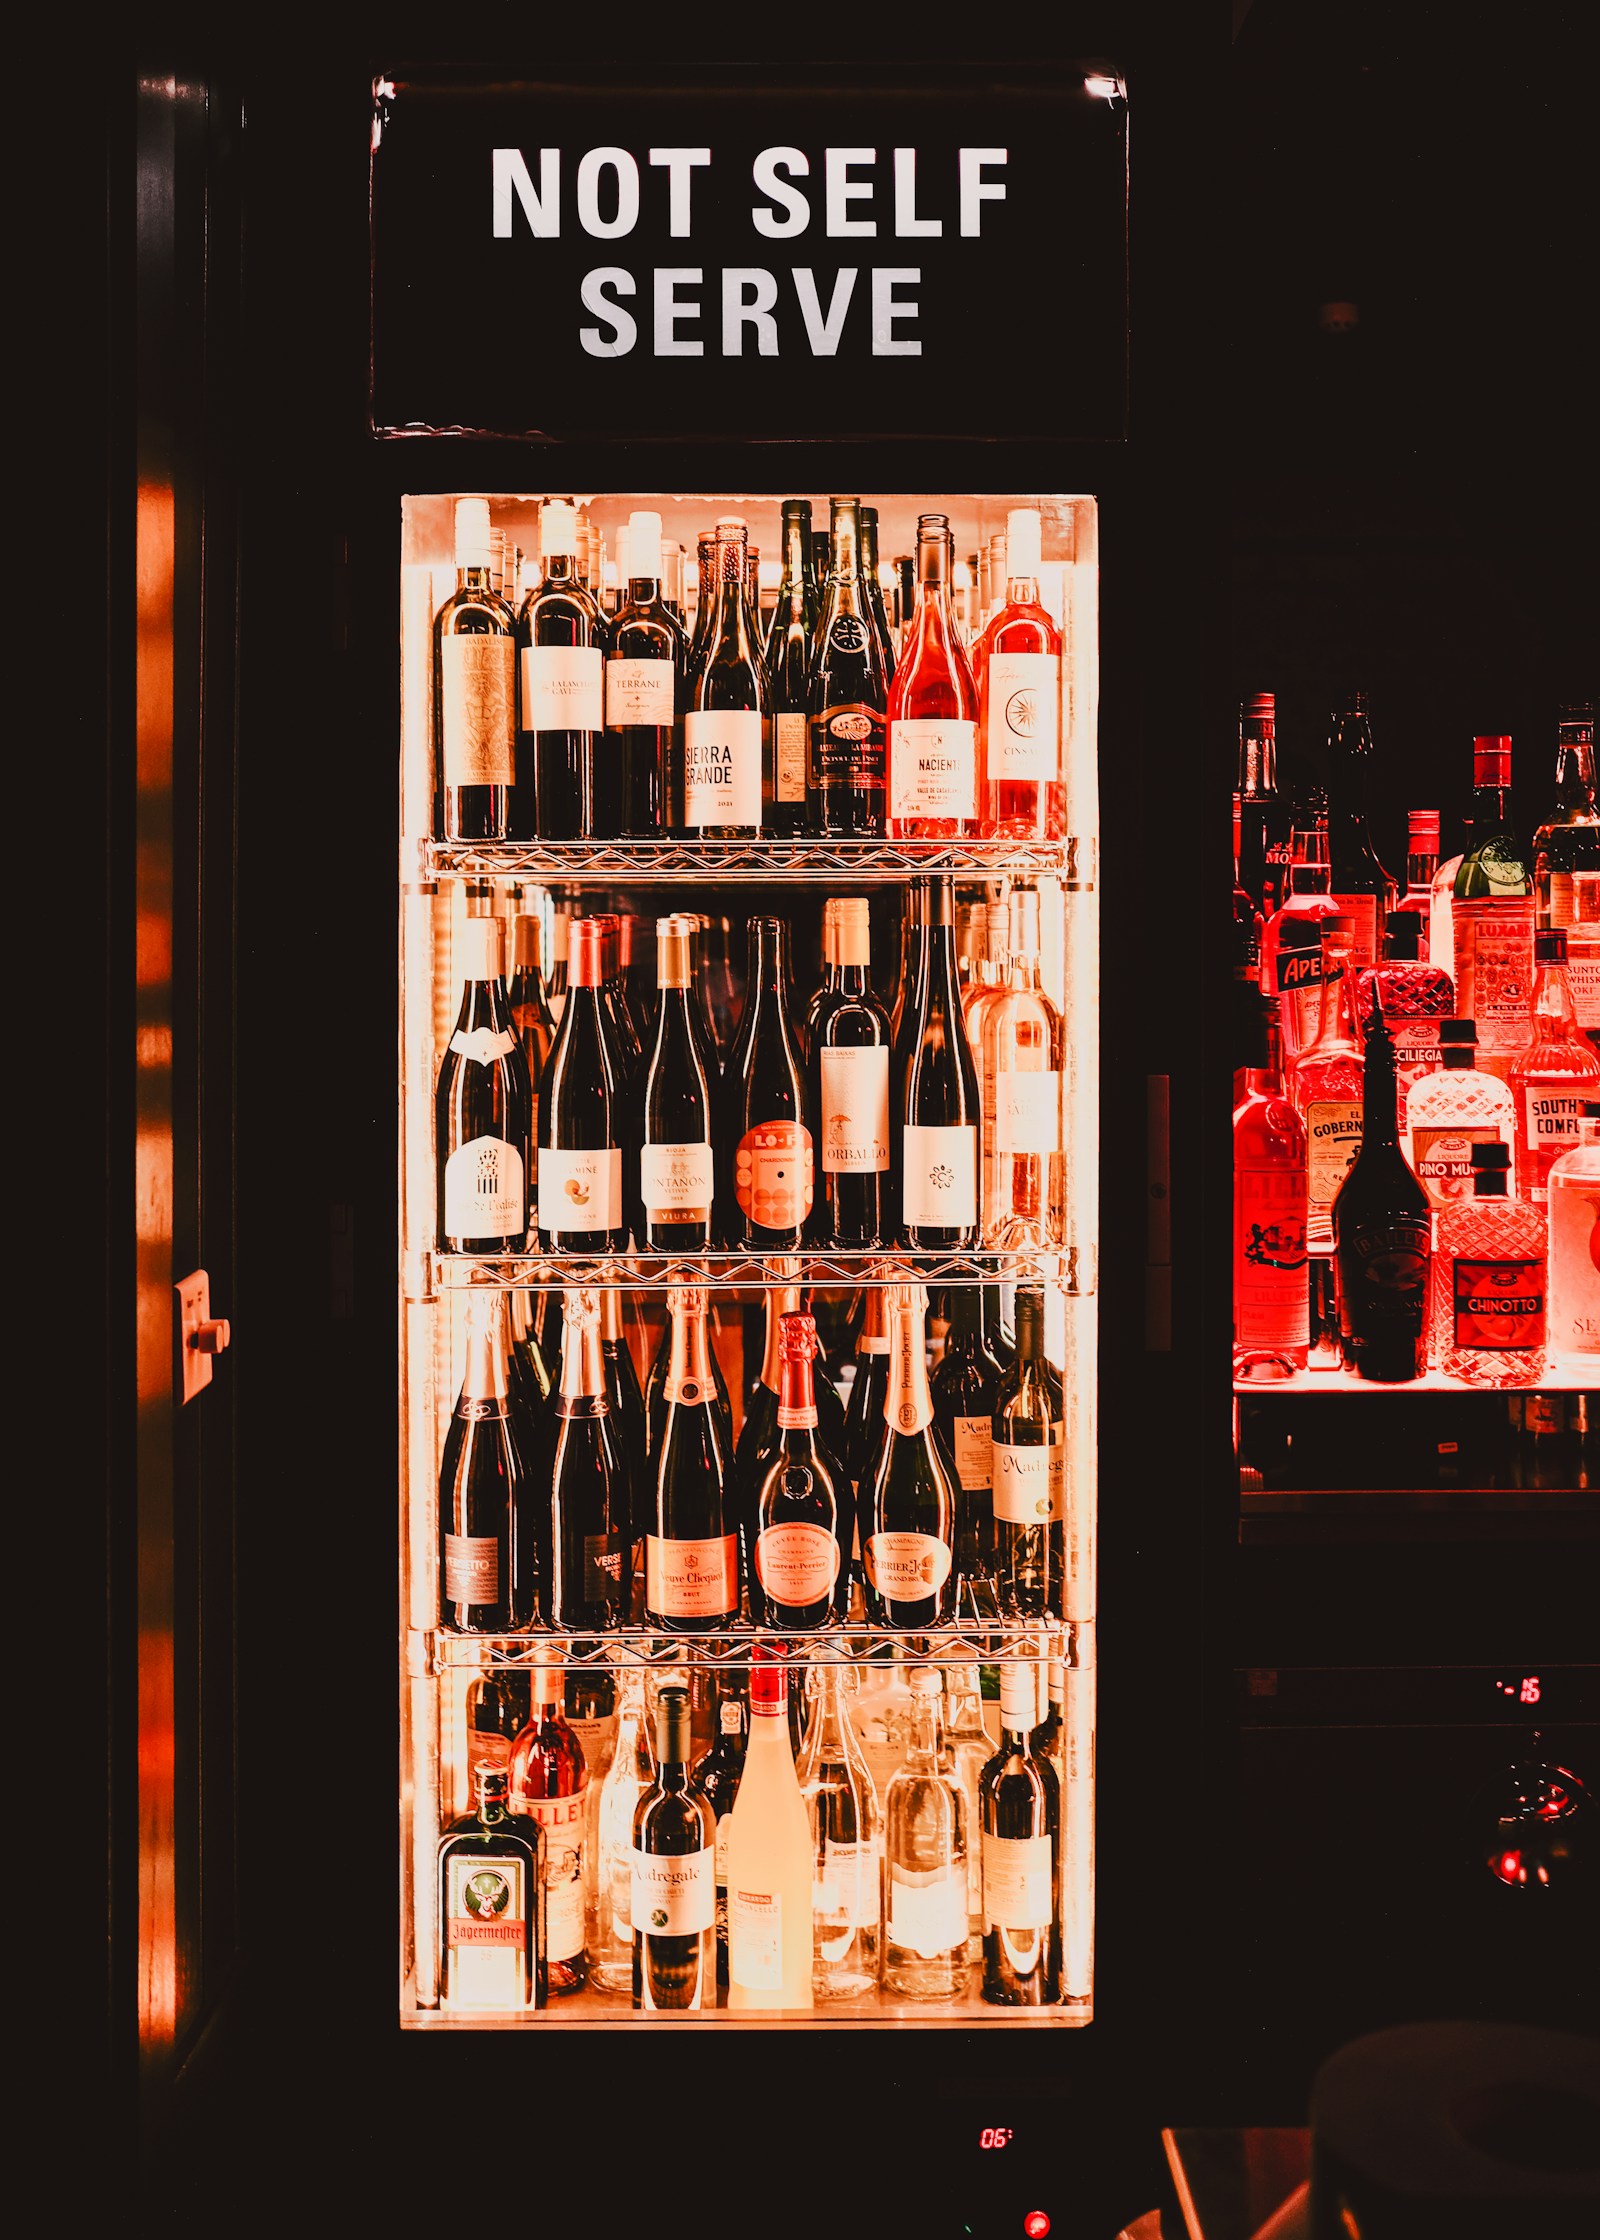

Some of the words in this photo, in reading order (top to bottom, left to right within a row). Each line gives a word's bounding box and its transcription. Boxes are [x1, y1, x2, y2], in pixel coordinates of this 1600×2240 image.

[492, 146, 711, 239] NOT
[752, 146, 1008, 239] SELF
[579, 266, 922, 357] SERVE
[616, 680, 661, 688] TERRANE
[686, 745, 733, 765] SIERRA
[686, 766, 733, 786] GRANDE
[1572, 986, 1594, 995] OKI
[1397, 1049, 1443, 1062] CILIEGIA
[1350, 1111, 1361, 1119] EL
[1532, 1099, 1581, 1116] SOUTH
[1313, 1120, 1363, 1138] GOBERN
[827, 1147, 886, 1160] ORBALLO
[1419, 1163, 1447, 1176] PINO
[661, 1212, 696, 1220] VIURA
[1359, 1229, 1429, 1252] BAILEYS
[1467, 1298, 1537, 1313] CHINOTTO
[686, 1572, 724, 1586] Clicquot
[632, 1862, 700, 1886] dregale
